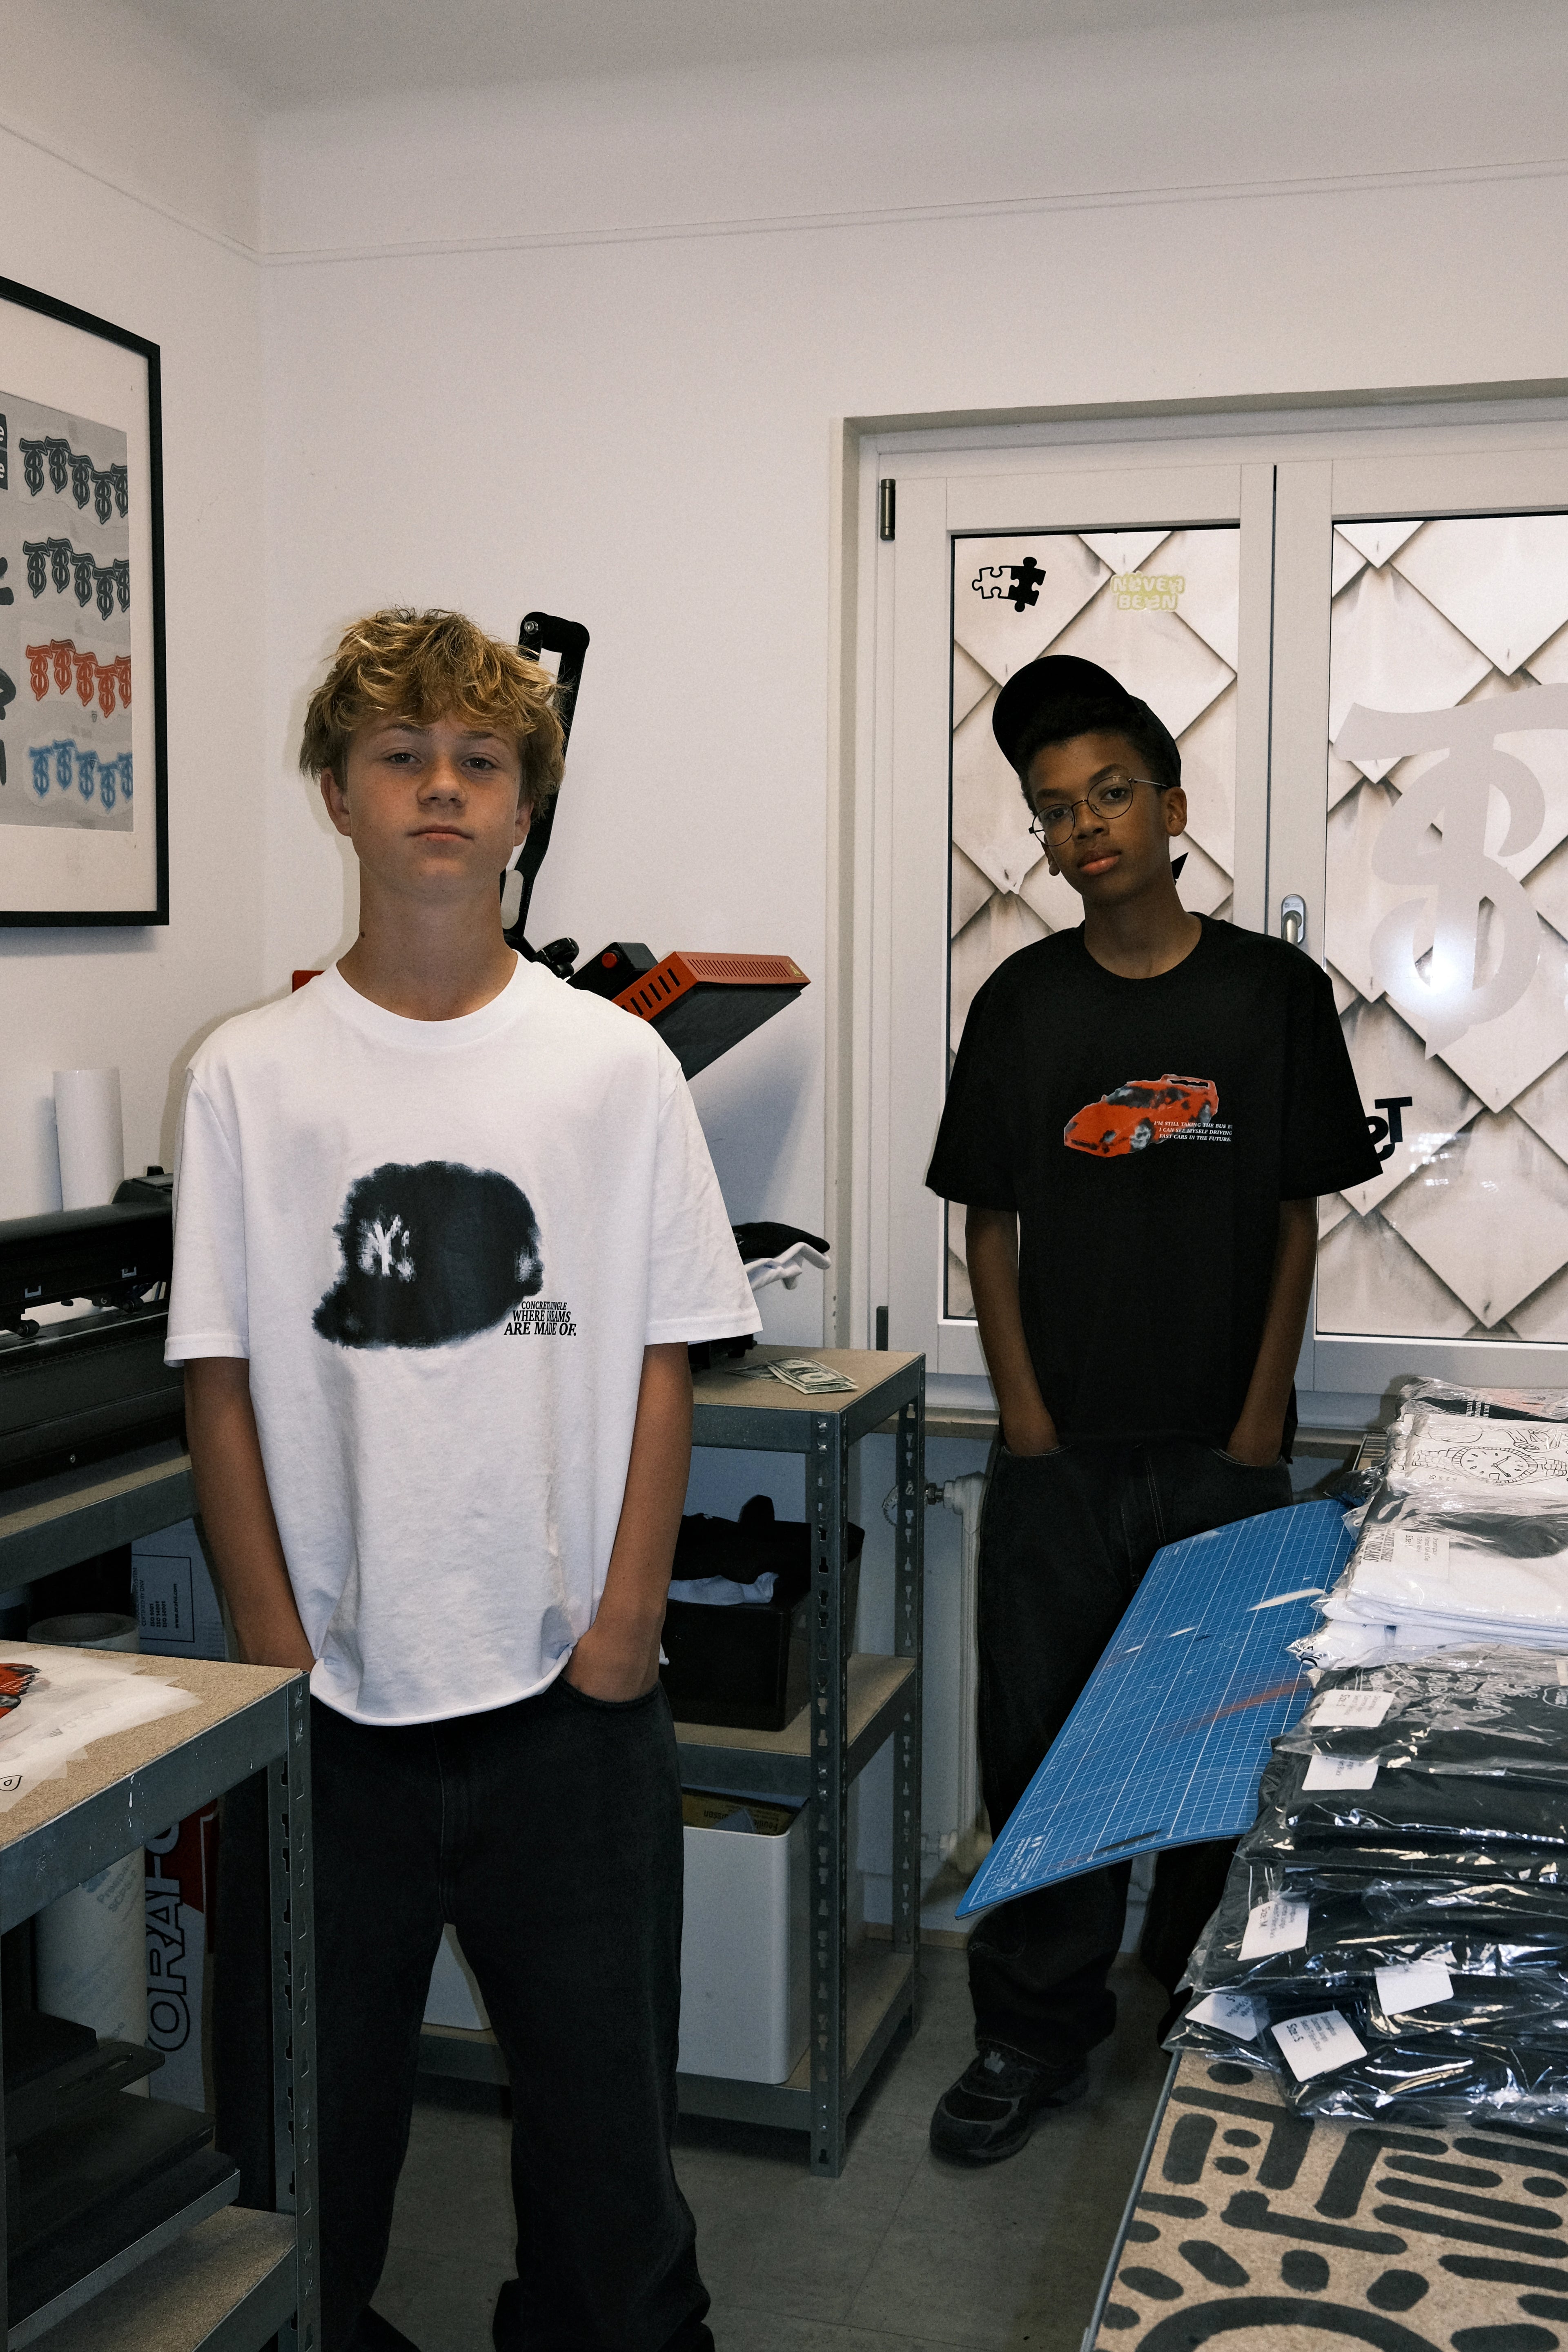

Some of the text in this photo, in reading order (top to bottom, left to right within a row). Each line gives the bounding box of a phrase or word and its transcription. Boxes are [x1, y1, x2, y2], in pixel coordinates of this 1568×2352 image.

[1113, 577, 1183, 594] NEVER
[1118, 594, 1176, 609] BEEN
[513, 1310, 571, 1323] WHERE DREAMS
[504, 1322, 577, 1336] ARE MADE OF.
